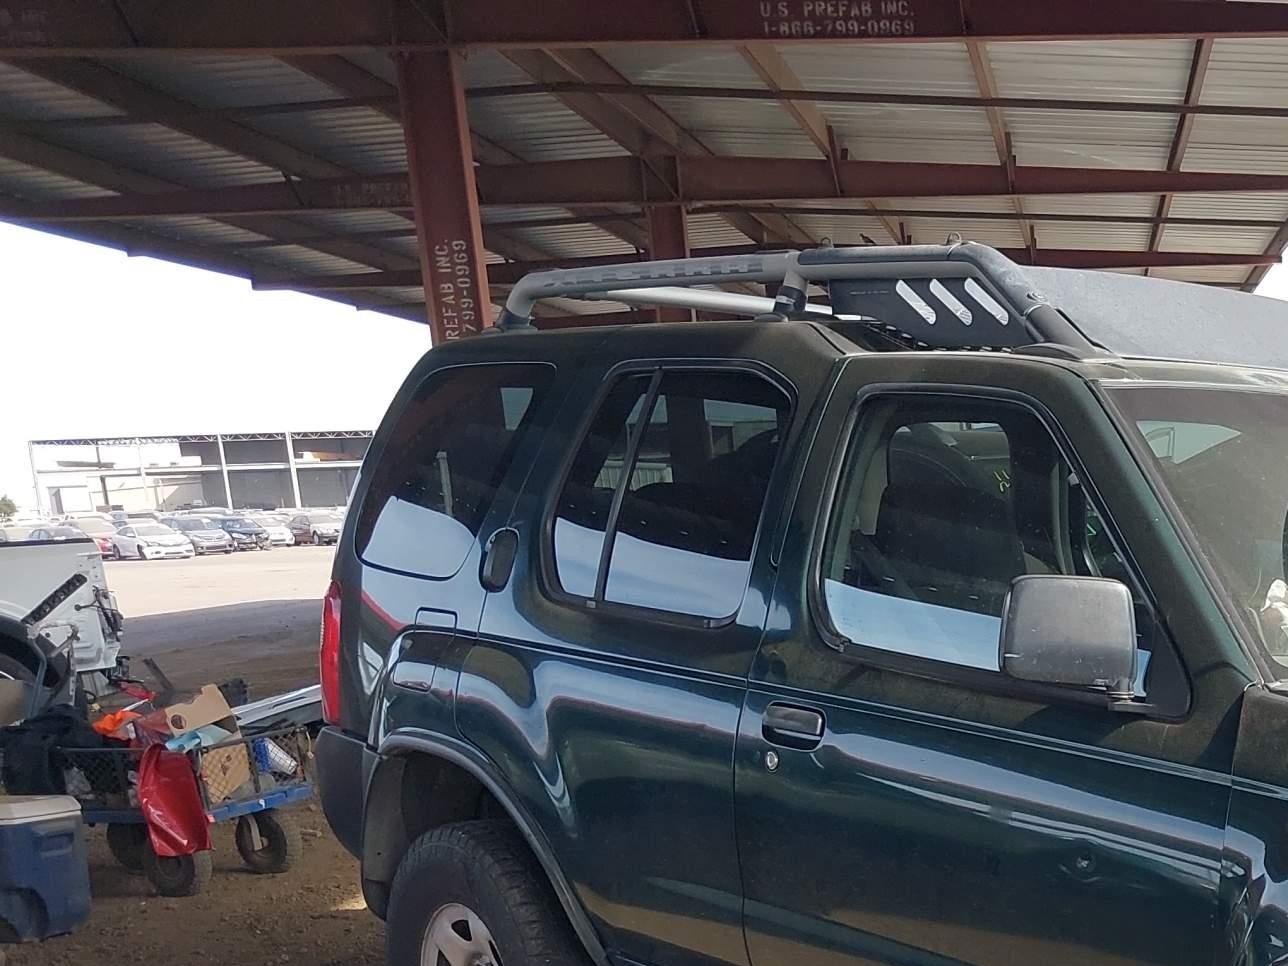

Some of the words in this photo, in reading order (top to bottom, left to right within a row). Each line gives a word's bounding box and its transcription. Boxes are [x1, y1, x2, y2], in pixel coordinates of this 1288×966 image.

[803, 1, 871, 17] PREFAB
[880, 1, 915, 16] INC.
[763, 19, 915, 36] 1-866-799-0969
[435, 239, 452, 273] INC.
[451, 239, 478, 333] 799-0969
[440, 282, 461, 341] REFAB
